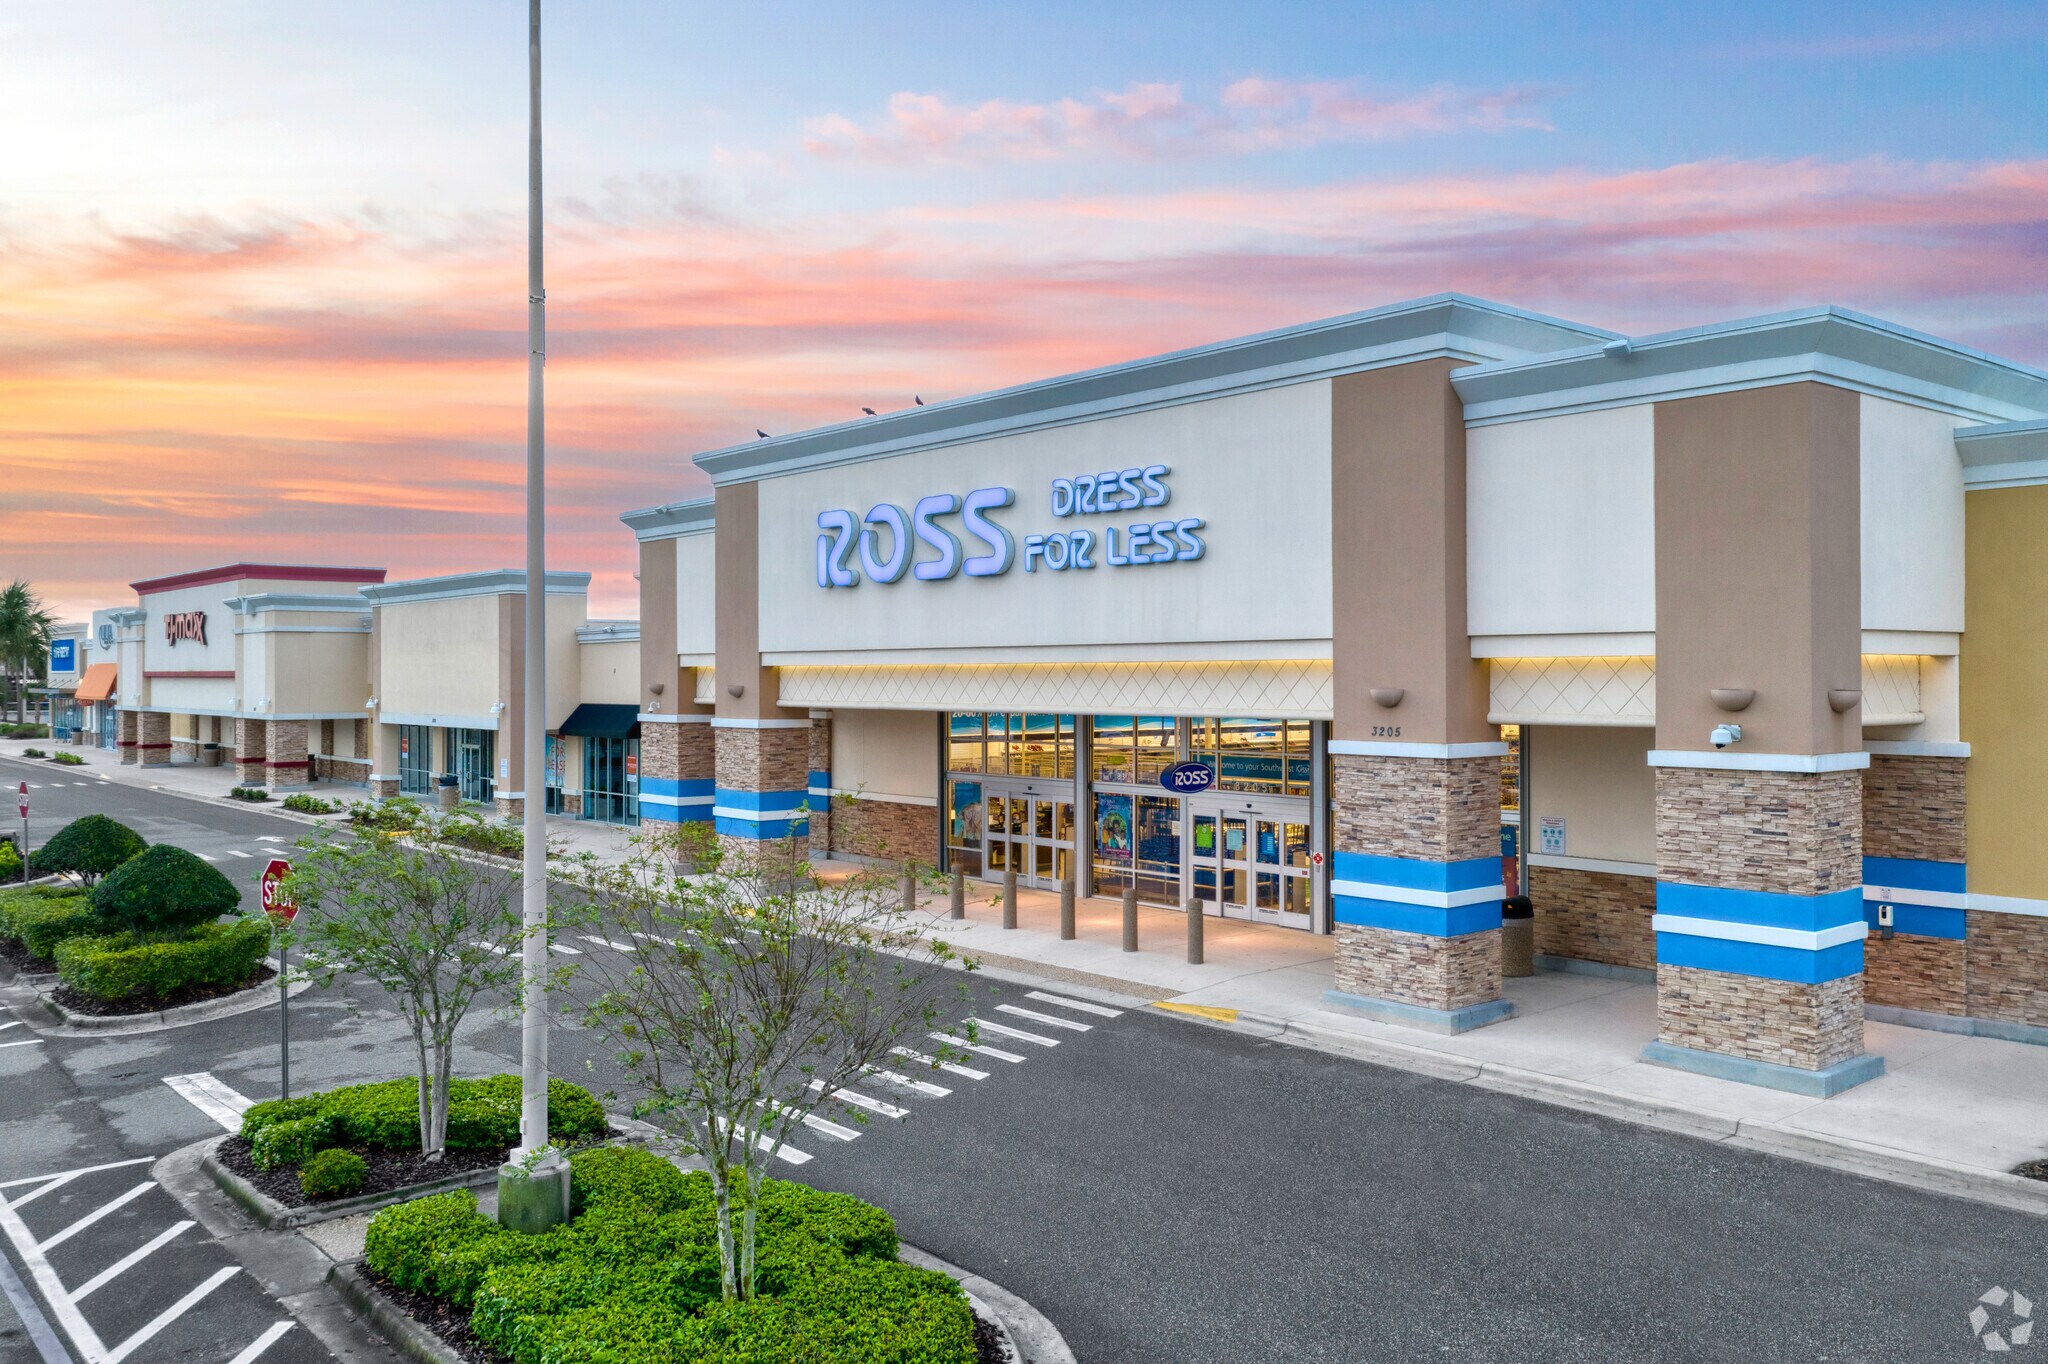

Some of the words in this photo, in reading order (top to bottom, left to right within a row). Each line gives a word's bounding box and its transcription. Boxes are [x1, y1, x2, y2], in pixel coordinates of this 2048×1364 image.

[1052, 464, 1170, 517] DRESS
[817, 487, 1014, 588] ROSS
[1024, 529, 1096, 572] FOR
[1106, 518, 1206, 566] LESS
[1371, 726, 1401, 737] 3205
[1175, 770, 1209, 786] ROSS
